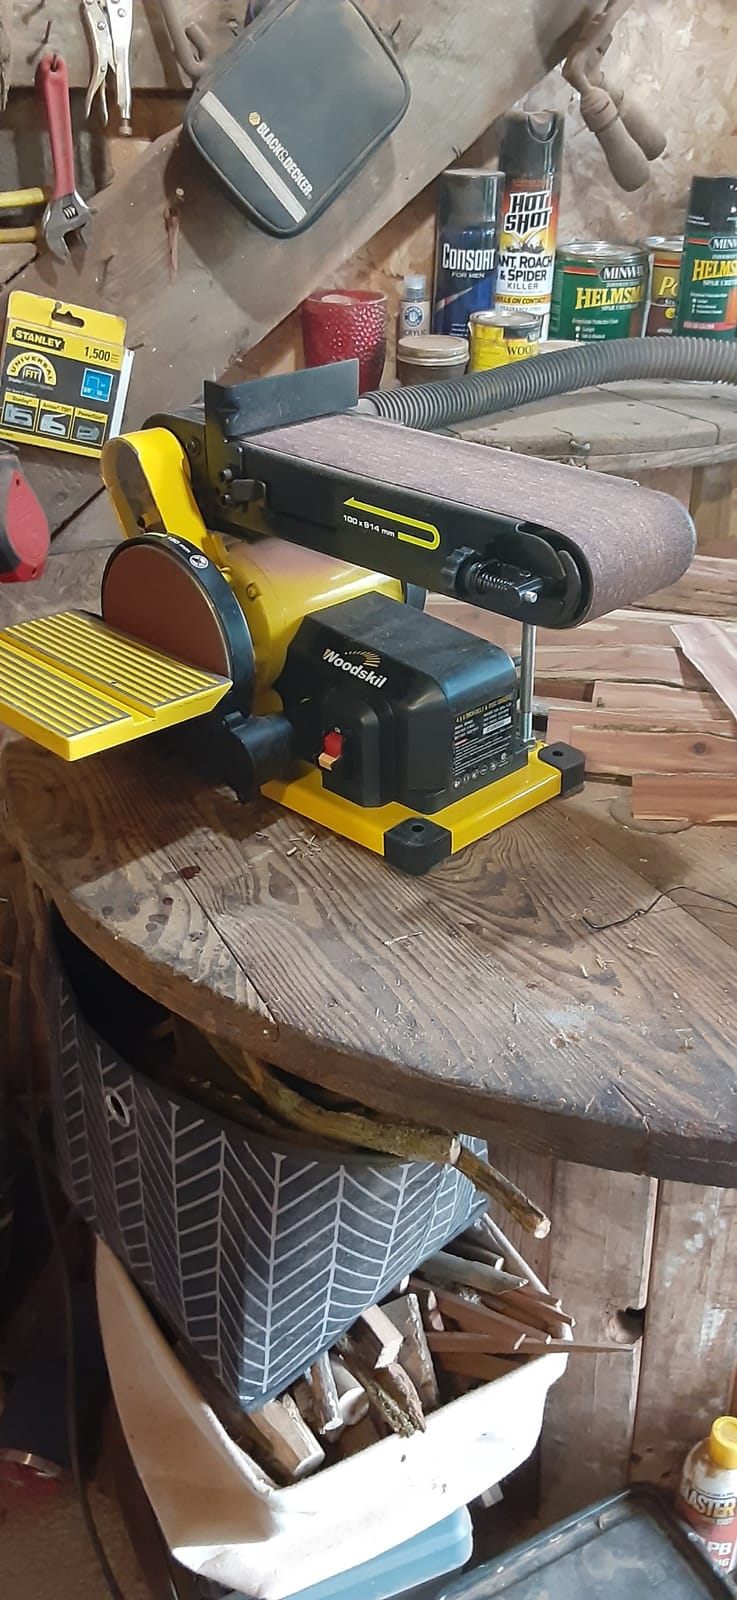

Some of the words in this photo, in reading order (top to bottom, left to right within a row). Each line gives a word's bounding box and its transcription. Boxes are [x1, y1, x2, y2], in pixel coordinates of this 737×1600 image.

[511, 193, 549, 213] HOT
[505, 211, 550, 234] SHOT
[519, 256, 553, 269] ROACH
[507, 270, 546, 281] SPIDER
[507, 282, 539, 291] KILLER
[15, 330, 62, 348] STANLEY
[84, 346, 111, 362] 1,500
[25, 369, 39, 380] FIT
[343, 515, 358, 524] 100
[364, 522, 380, 532] 914
[381, 529, 395, 538] mm
[323, 648, 388, 689] Woodskil
[687, 1488, 735, 1518] ASTER
